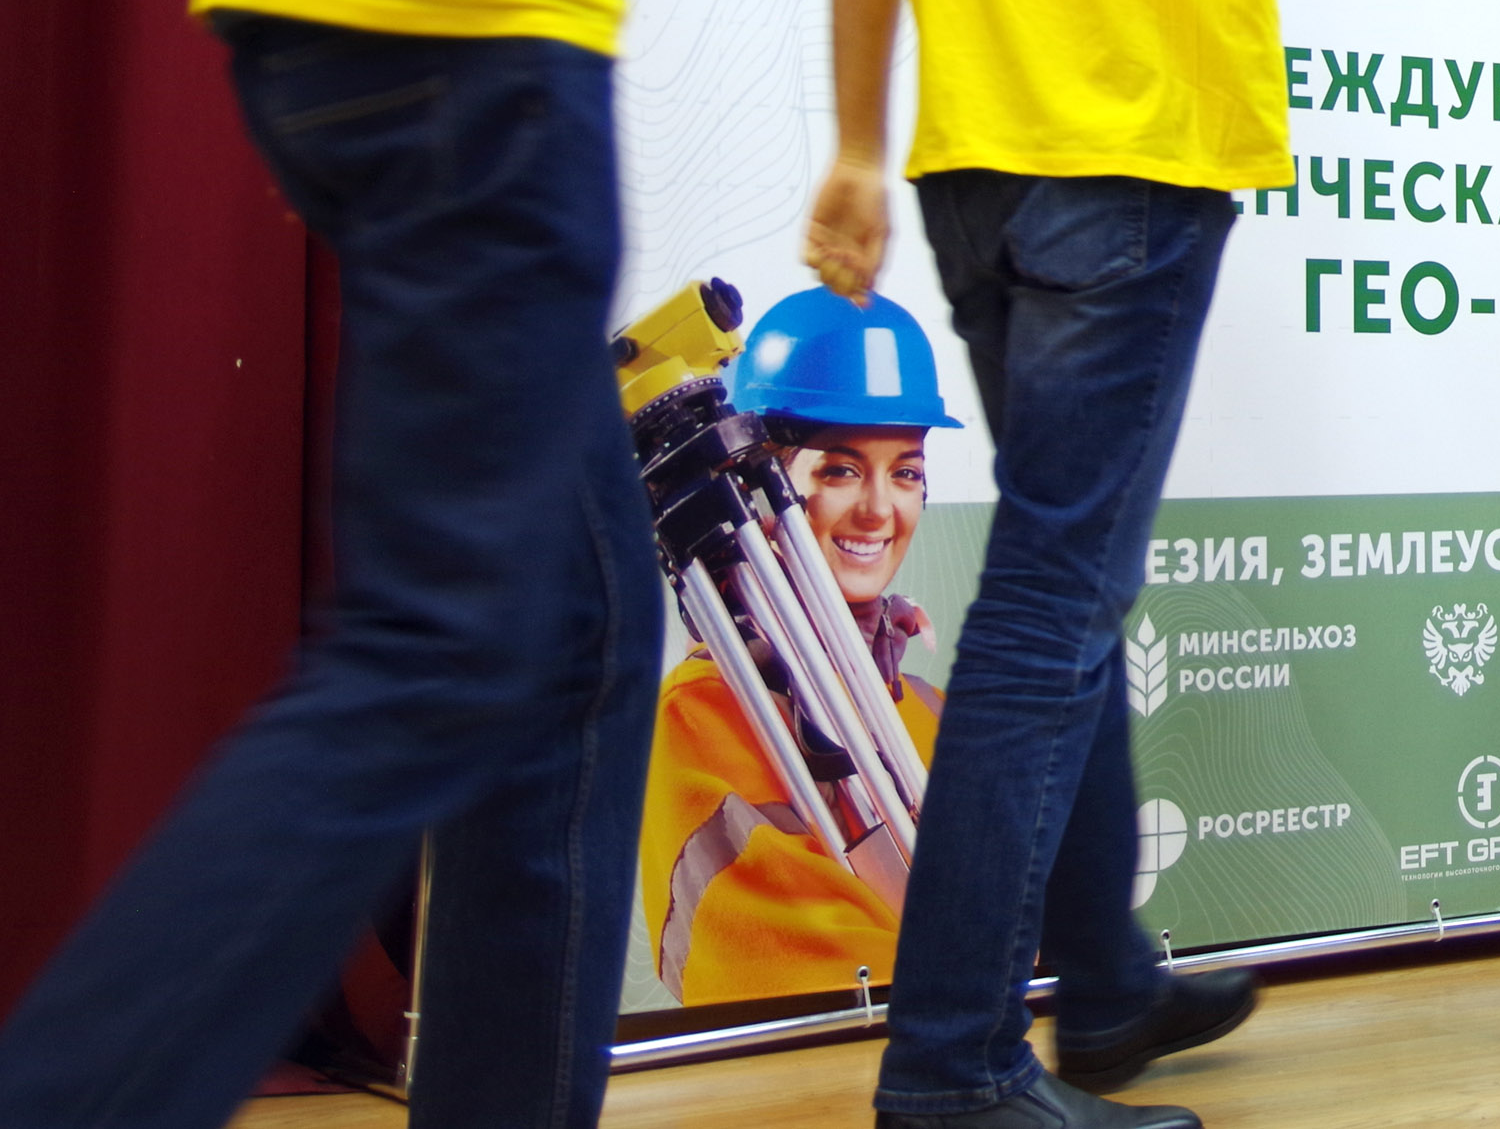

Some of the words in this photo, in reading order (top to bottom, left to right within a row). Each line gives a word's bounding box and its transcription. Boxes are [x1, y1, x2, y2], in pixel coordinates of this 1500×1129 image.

[1145, 535, 1285, 586] ЕЗИЯ,
[1178, 623, 1358, 657] МИНСЕЛЬХОЗ
[1179, 663, 1290, 694] РОССИИ
[1198, 802, 1352, 841] РОСРЕЕСТР
[1400, 841, 1459, 870] EFT
